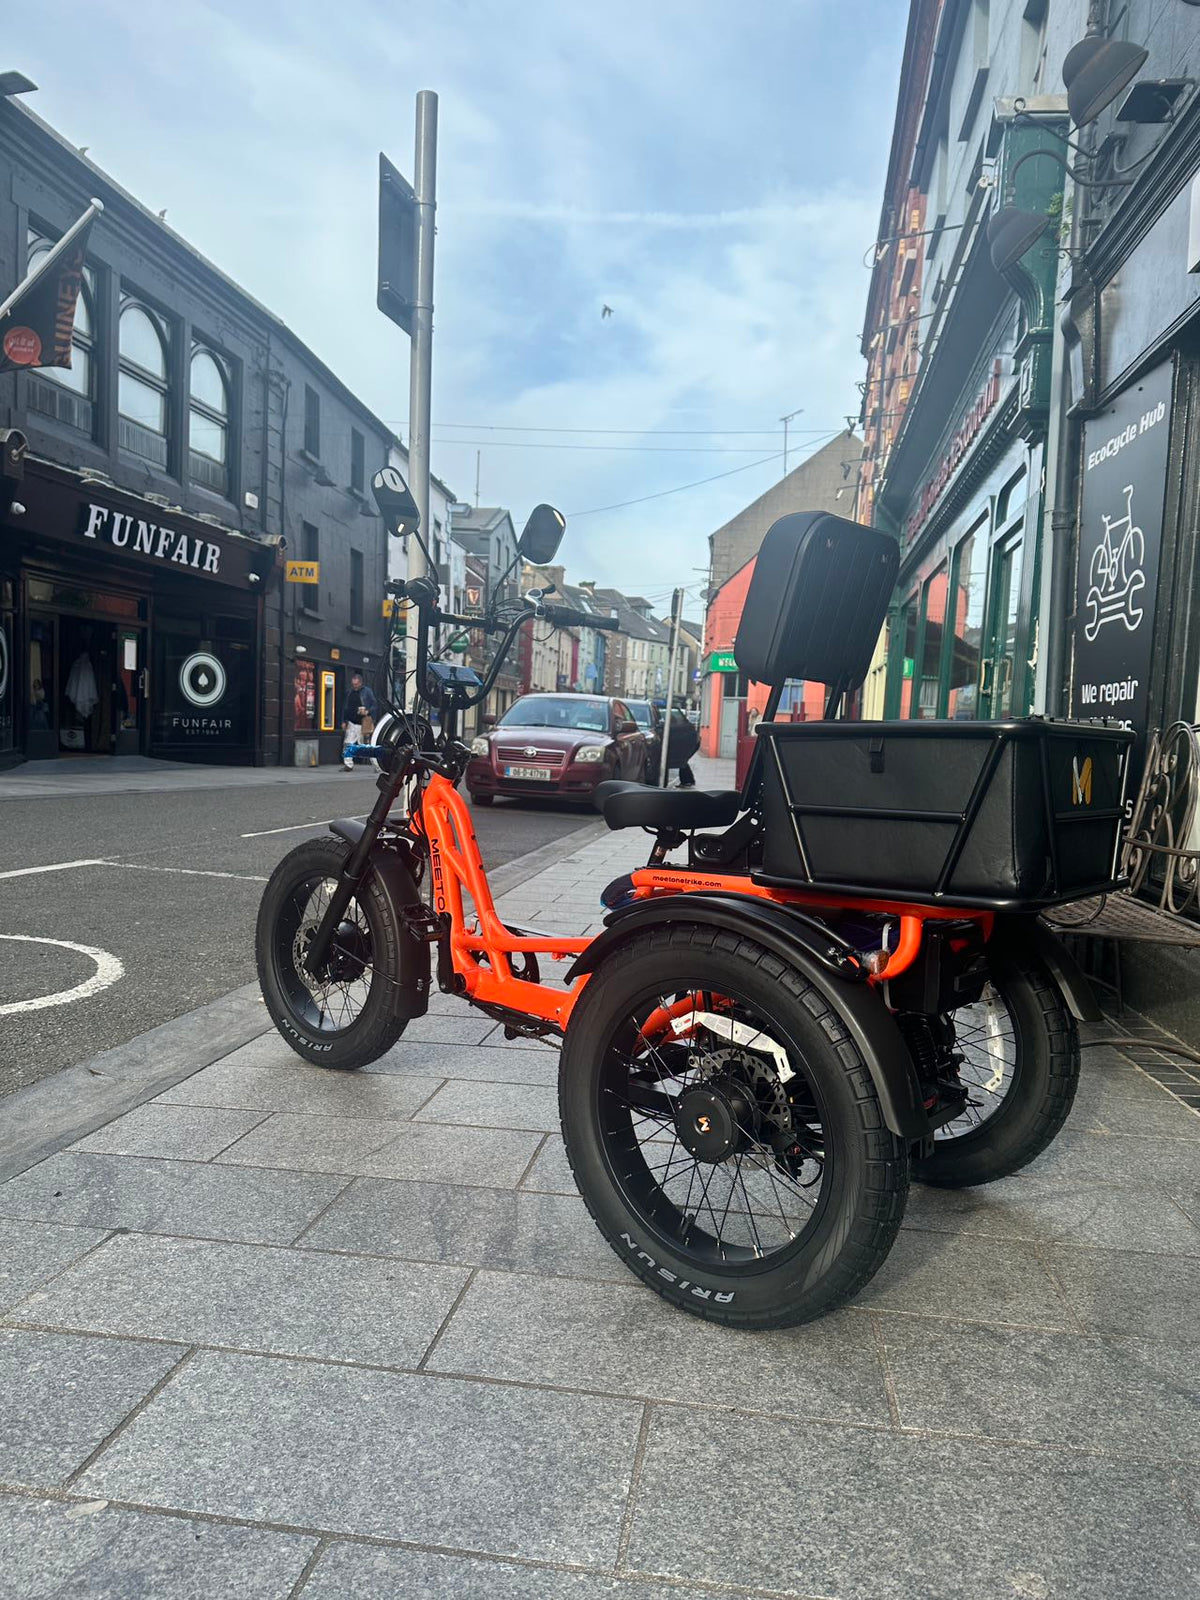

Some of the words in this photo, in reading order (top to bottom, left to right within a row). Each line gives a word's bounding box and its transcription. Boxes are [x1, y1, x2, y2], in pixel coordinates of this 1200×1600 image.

[1088, 423, 1137, 470] EcoCycle
[1139, 401, 1166, 435] Hub
[84, 503, 221, 574] FUNFAIR
[290, 567, 314, 577] ATM
[1082, 684, 1097, 704] We
[1100, 676, 1139, 706] repair
[172, 717, 232, 728] FUNFAIR
[652, 875, 722, 888] meetonetrike.com
[282, 1018, 334, 1052] ARISUN
[620, 1232, 735, 1303] ARISUN
